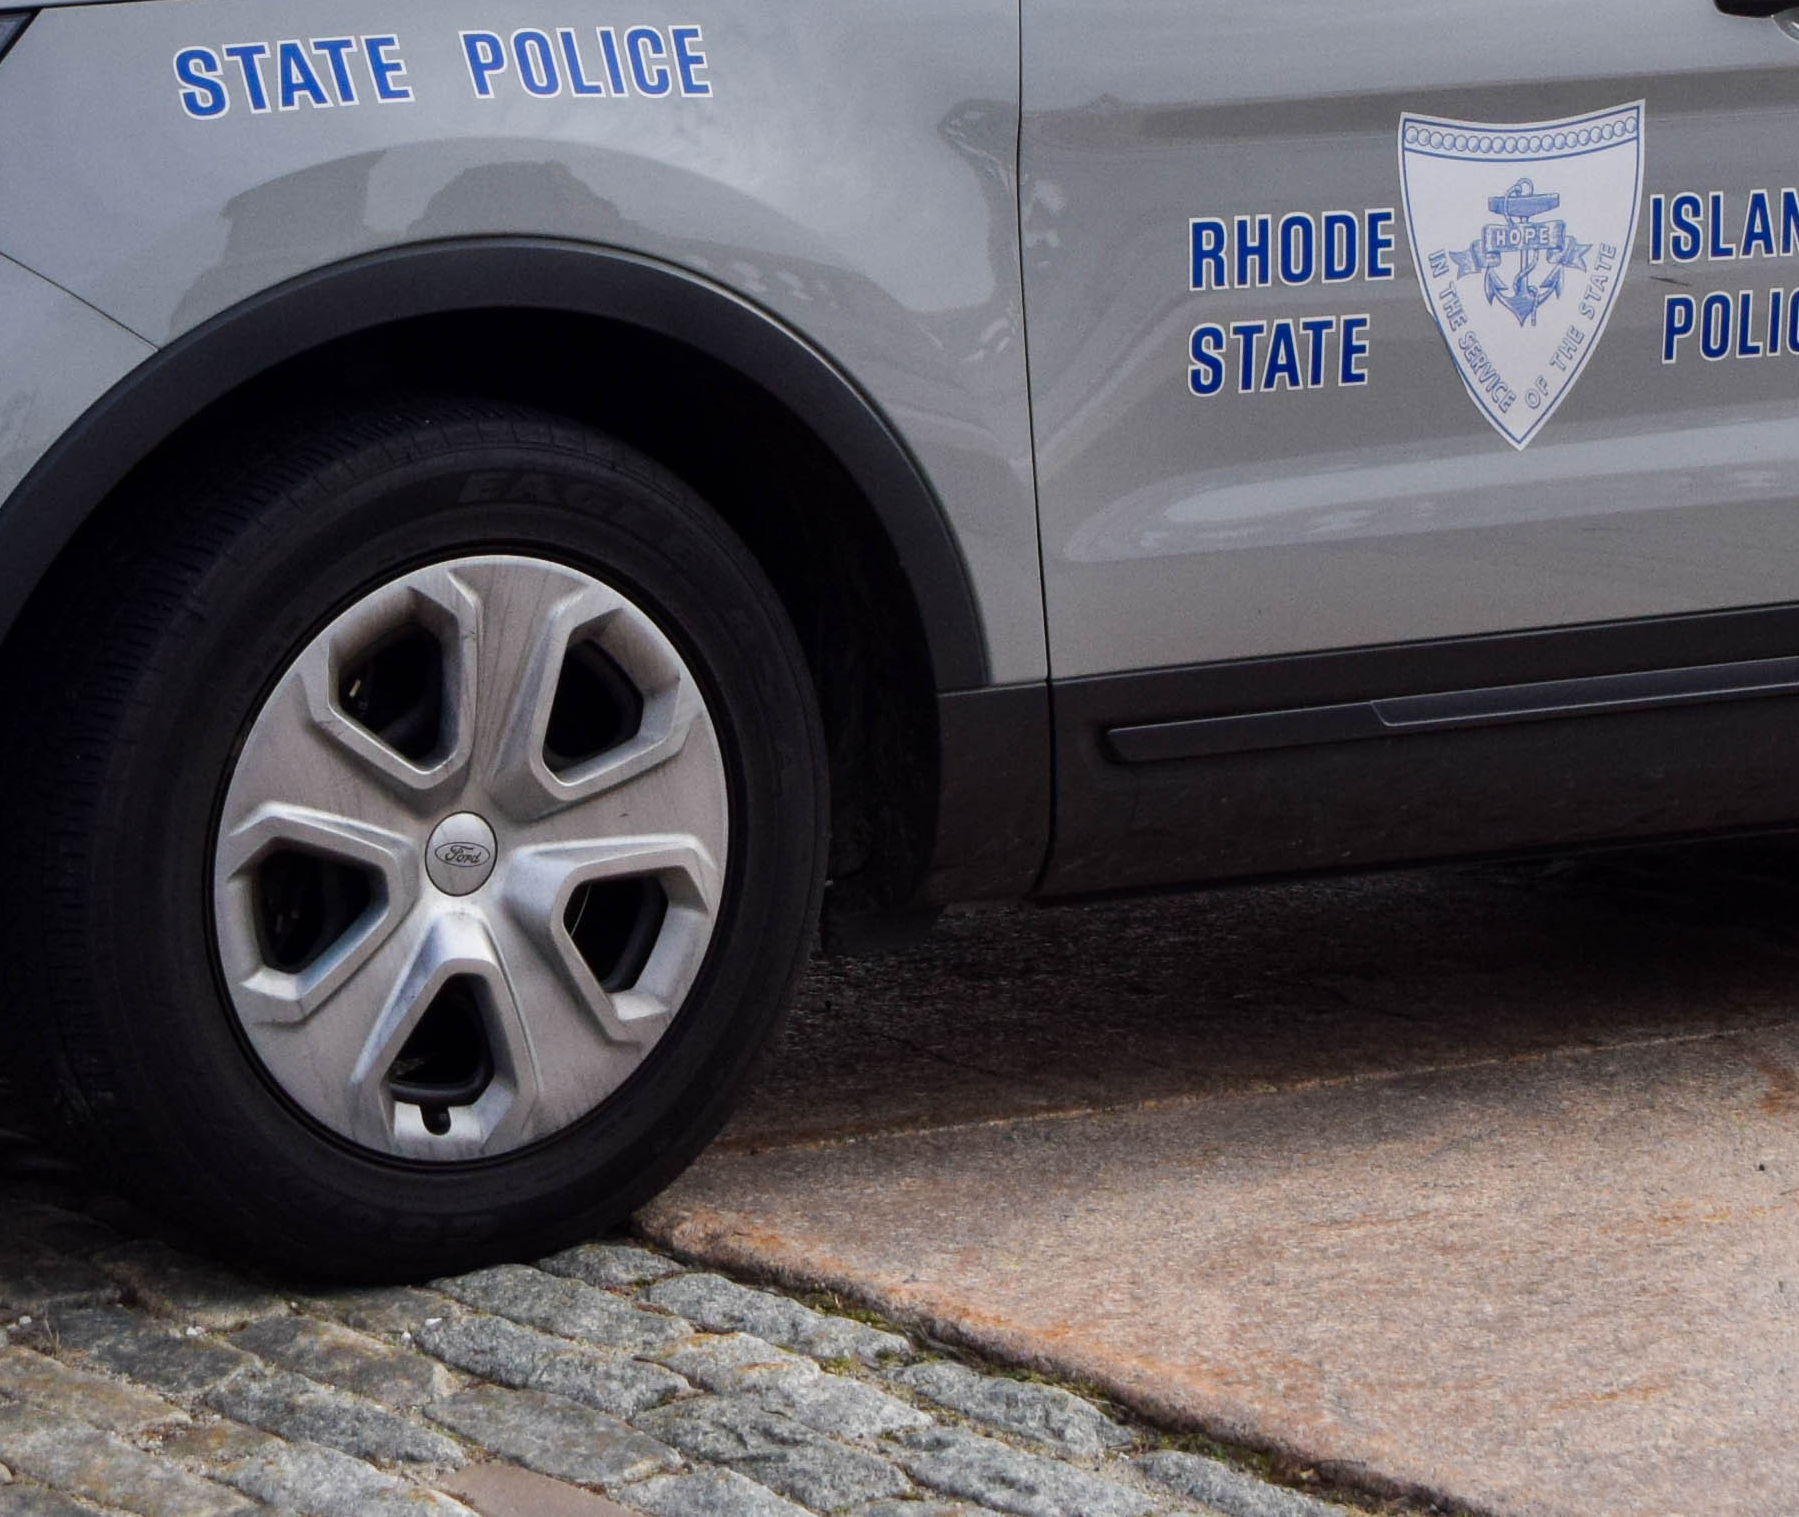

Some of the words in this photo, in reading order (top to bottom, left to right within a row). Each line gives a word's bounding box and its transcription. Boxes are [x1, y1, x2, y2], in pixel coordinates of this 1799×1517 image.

[173, 33, 415, 120] STATE
[458, 24, 713, 98] POLICE
[1189, 208, 1395, 291] RHODE
[1496, 225, 1549, 246] HOPE
[1189, 314, 1370, 396] STATE
[1428, 249, 1450, 279] IN
[1439, 282, 1468, 332] THE
[1458, 331, 1517, 413] SERVICE
[1525, 376, 1549, 410] OF
[1551, 325, 1585, 373] THE
[1581, 243, 1617, 319] STATE
[445, 844, 482, 864] Ford
